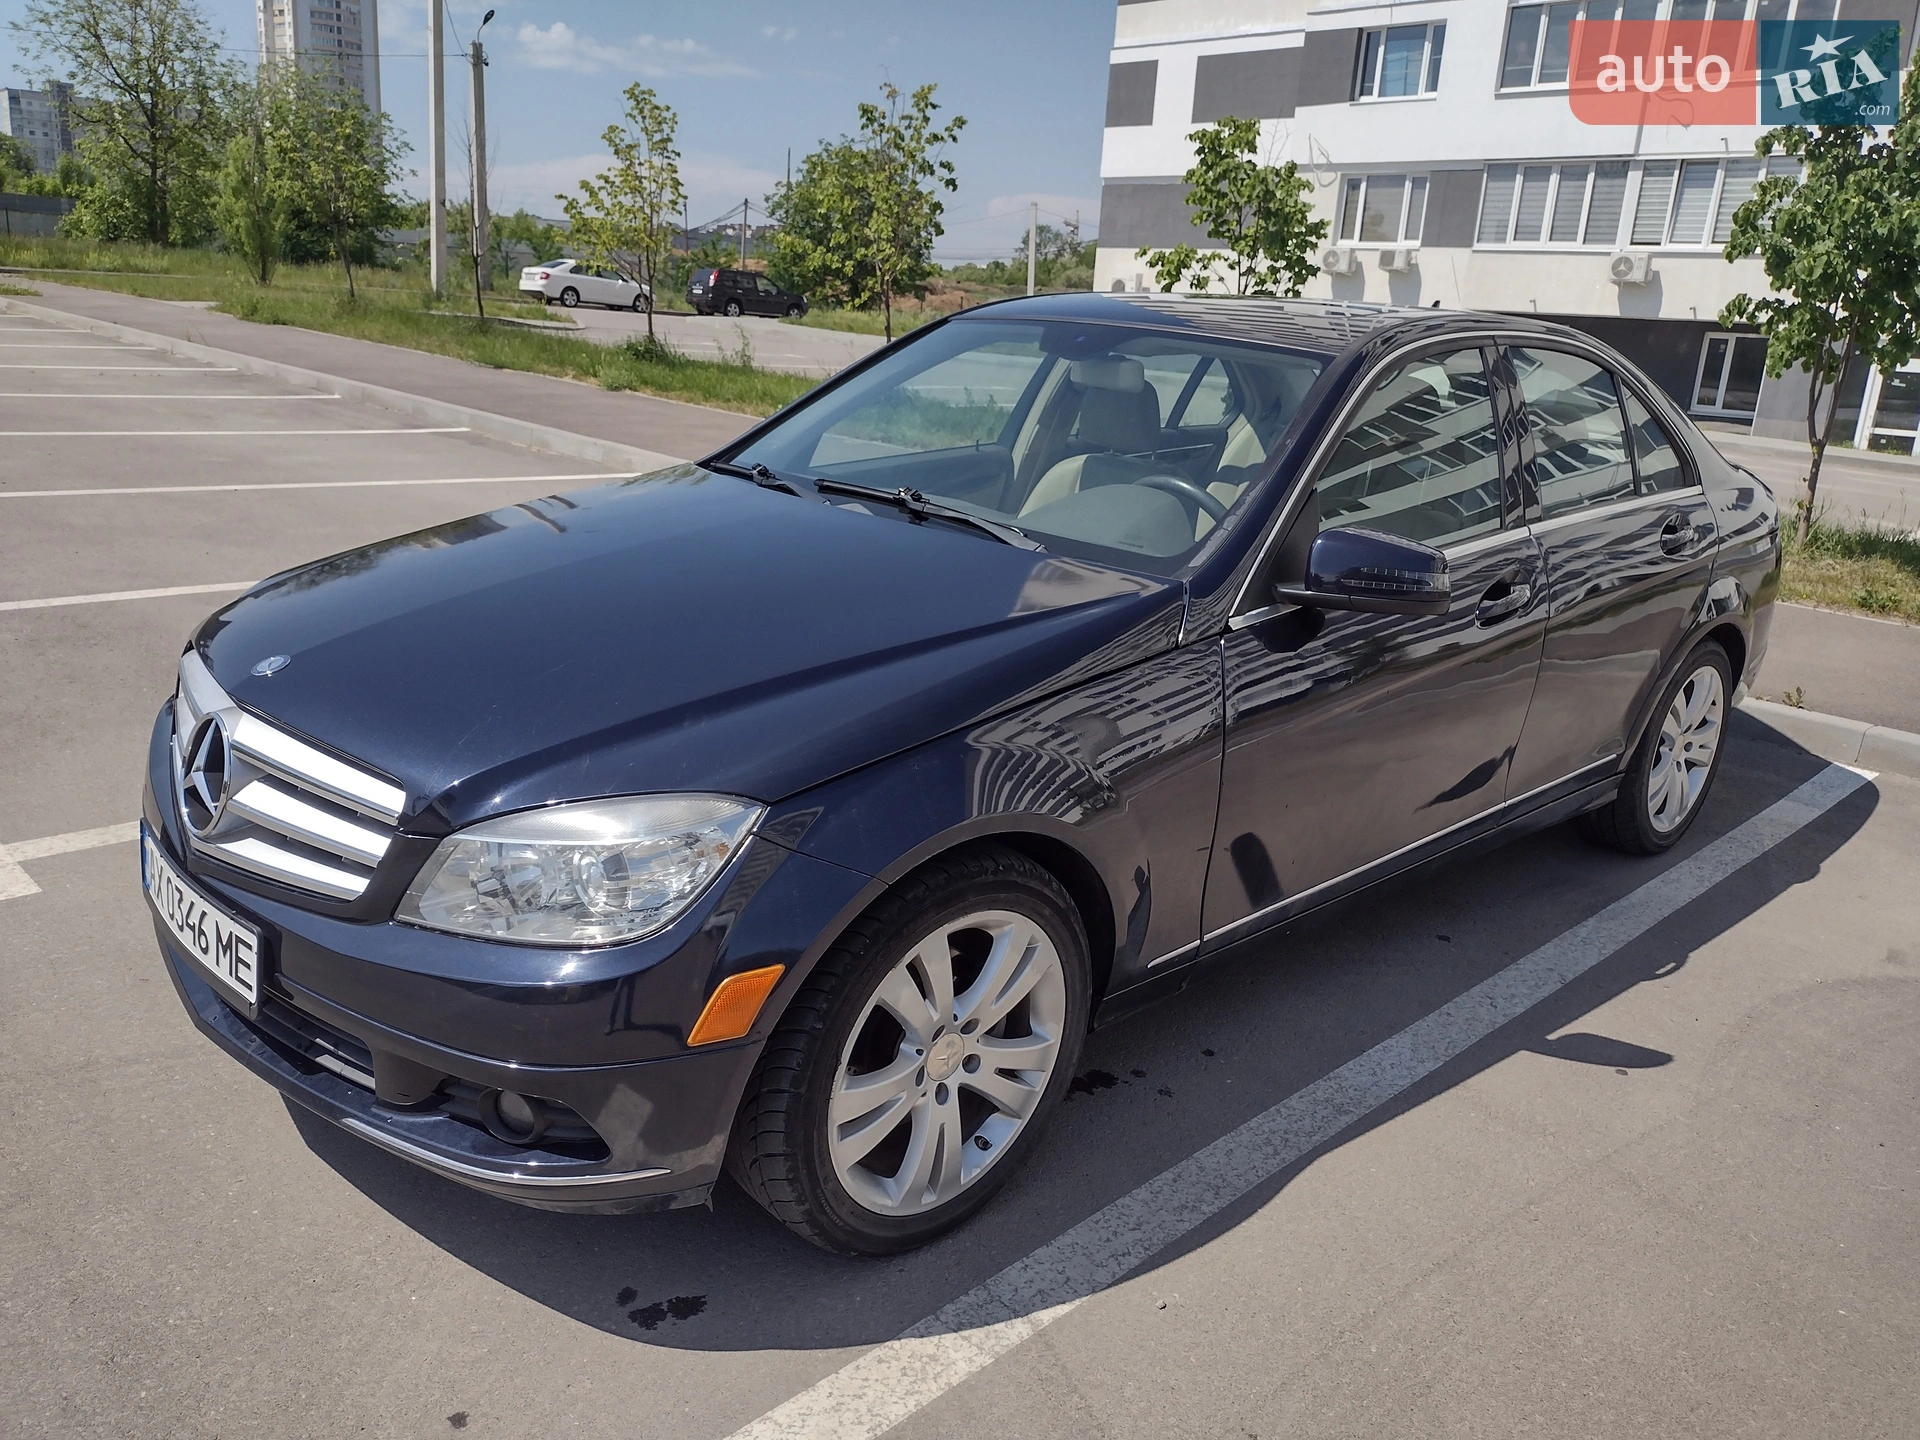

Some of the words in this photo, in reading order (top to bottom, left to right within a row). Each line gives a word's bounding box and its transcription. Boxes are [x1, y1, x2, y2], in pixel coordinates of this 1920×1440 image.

[150, 847, 165, 909] AX
[166, 875, 209, 956] 0346
[214, 919, 253, 993] ME
